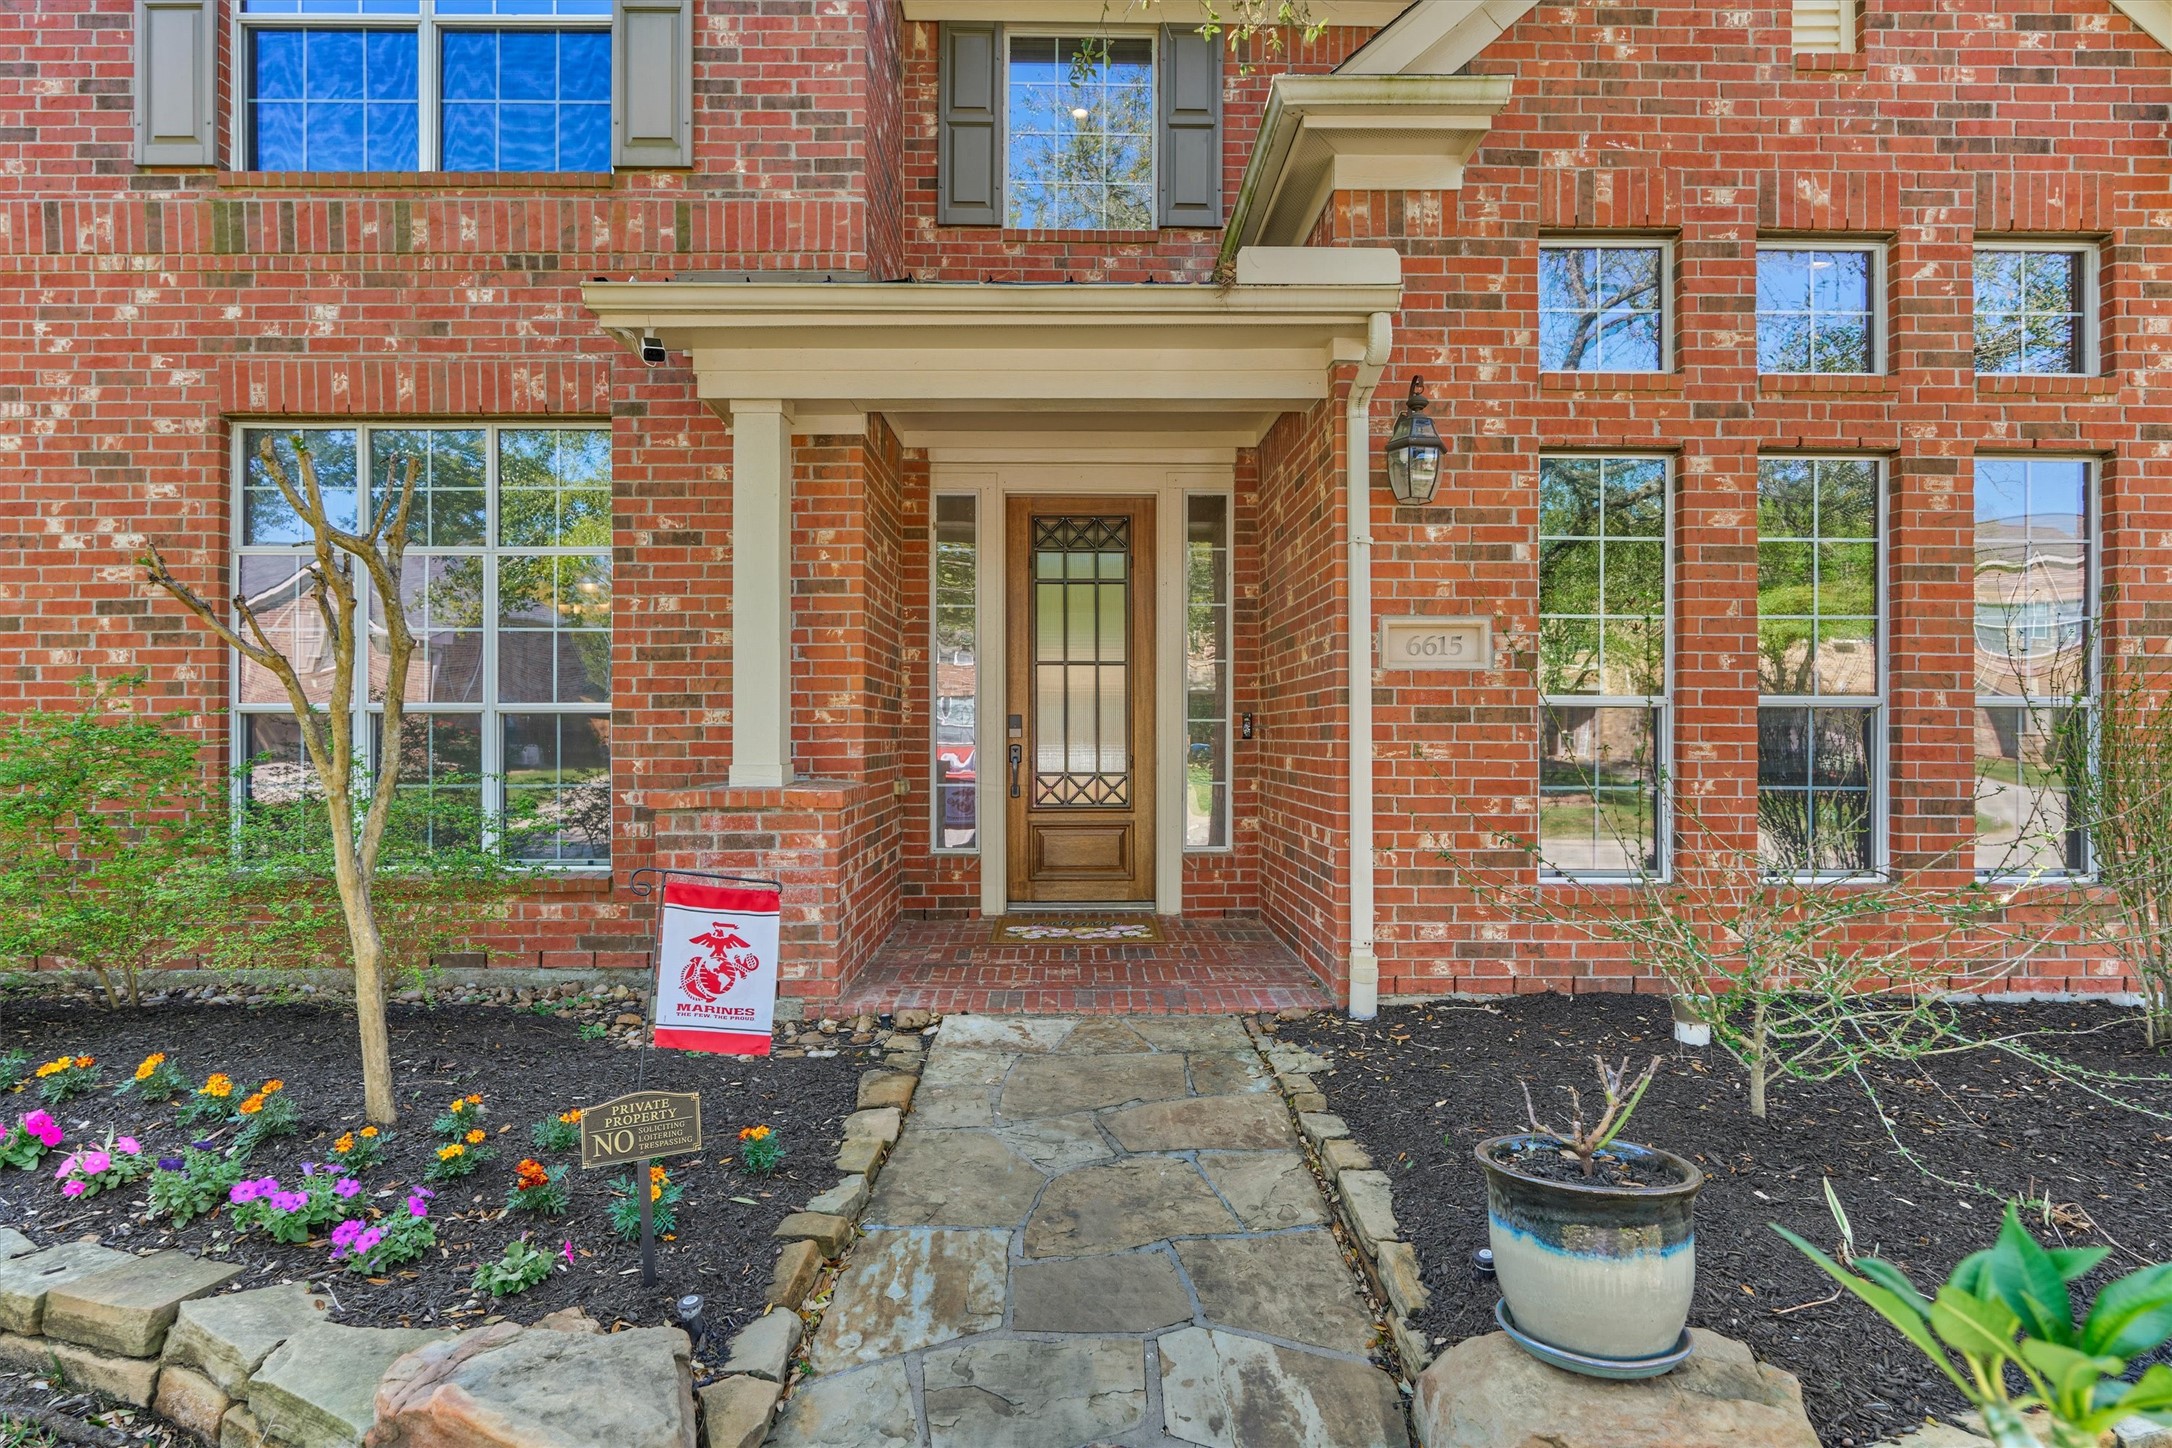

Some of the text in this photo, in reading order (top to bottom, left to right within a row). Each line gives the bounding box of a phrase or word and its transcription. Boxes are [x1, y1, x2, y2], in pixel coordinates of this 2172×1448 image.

[1405, 635, 1463, 656] 6615
[677, 1003, 755, 1017] MARINES
[612, 1098, 670, 1116] PRIVATE
[604, 1107, 678, 1128] PROPERTY
[638, 1120, 685, 1134] SOLICITING
[591, 1129, 635, 1158] NO
[638, 1129, 683, 1143] LOITERING
[638, 1135, 693, 1150] TRESPASSING
